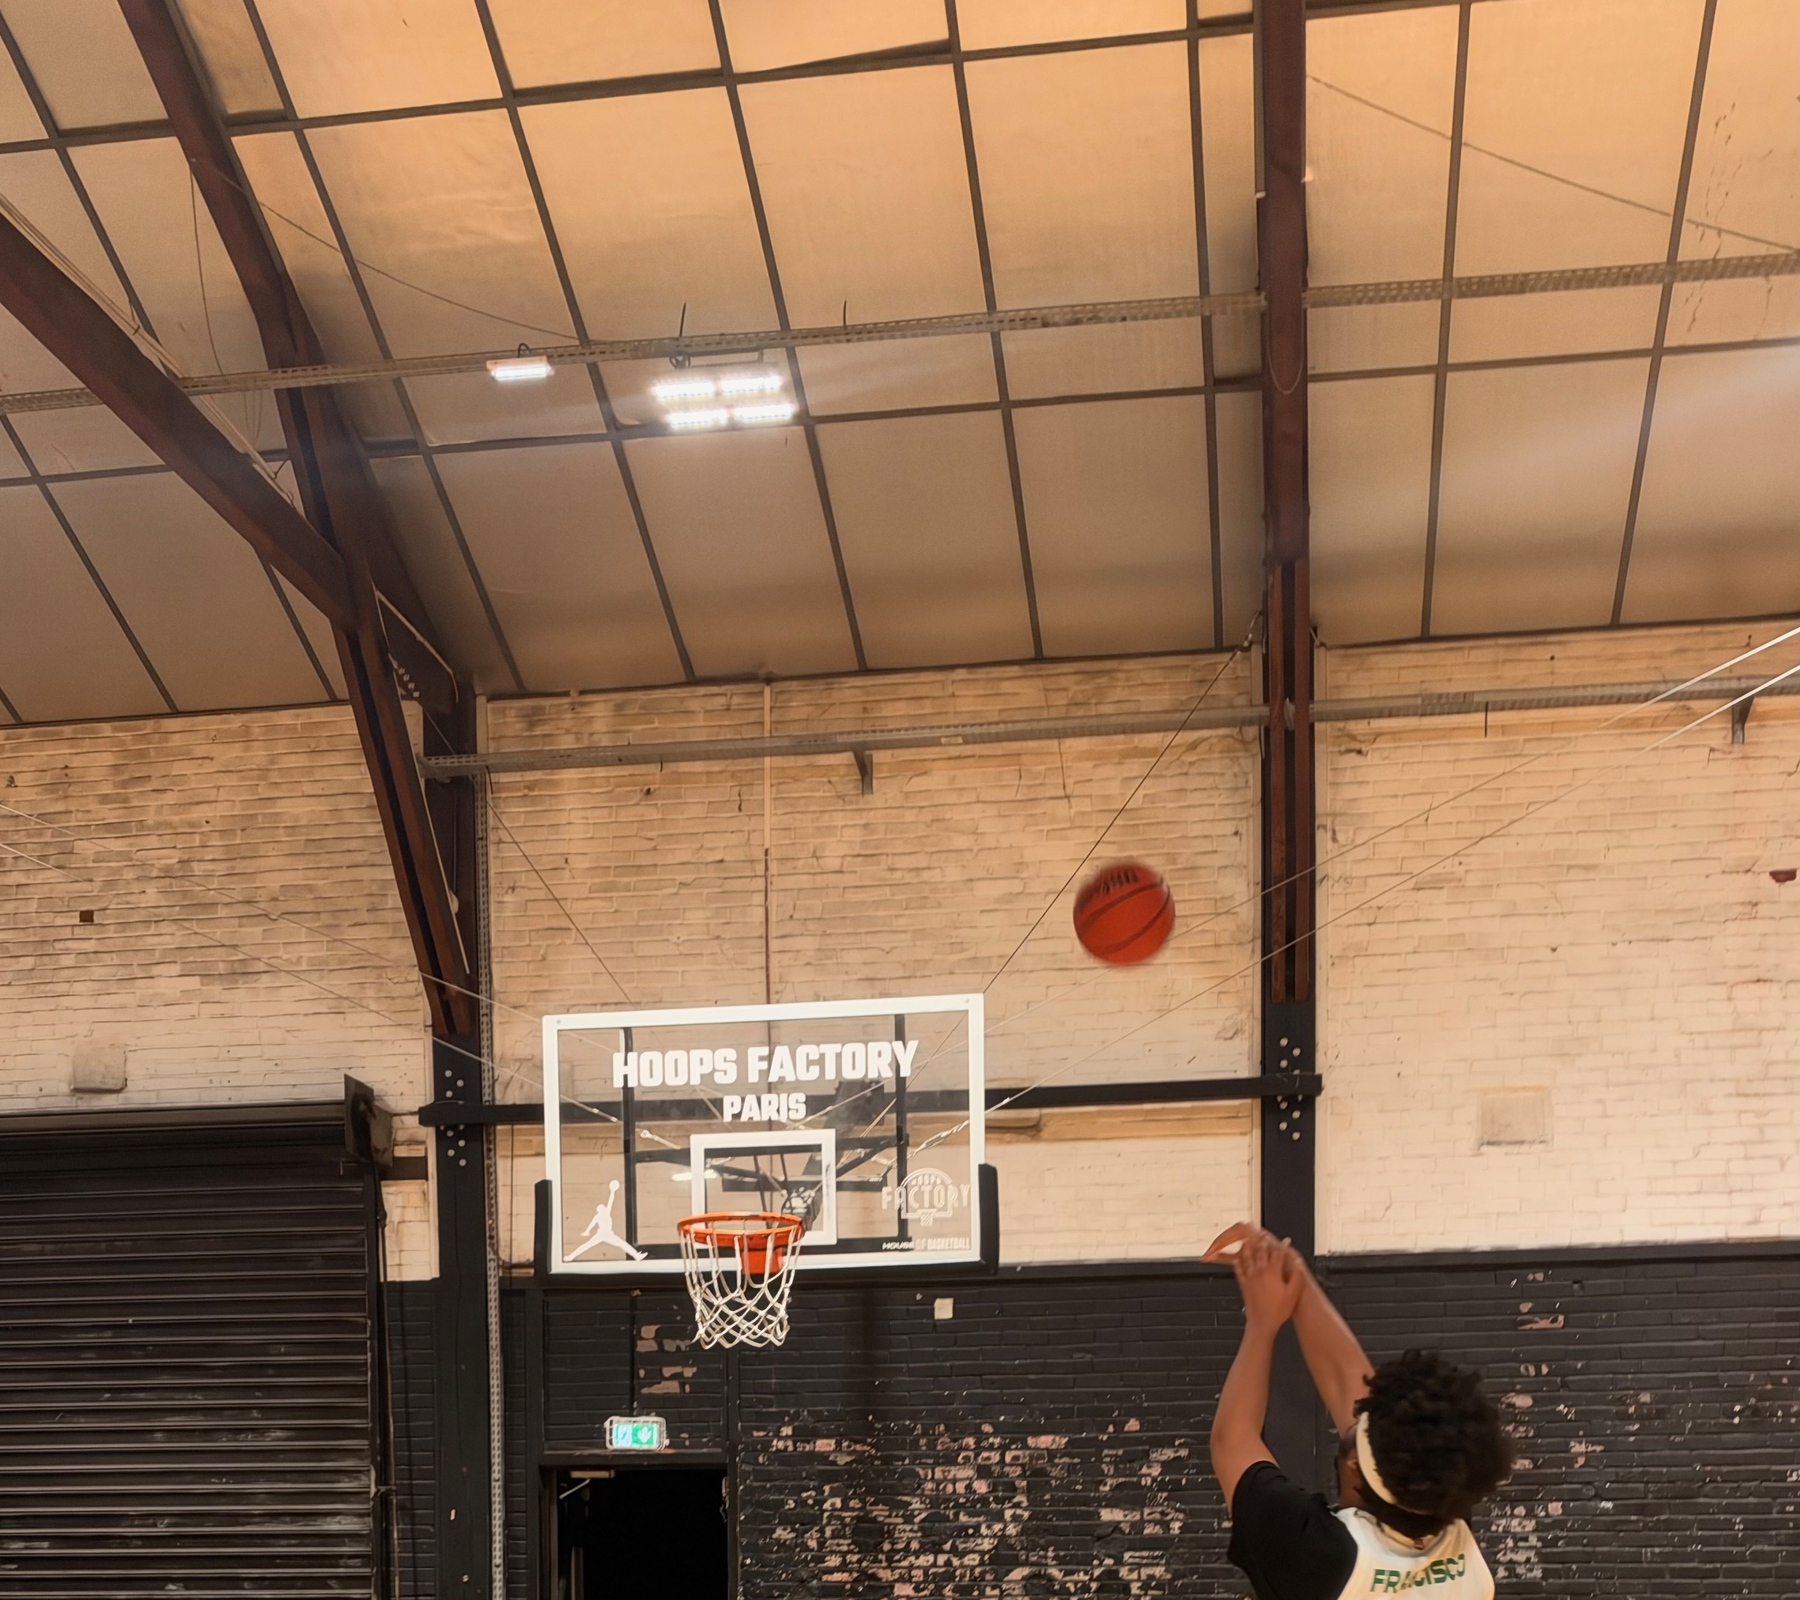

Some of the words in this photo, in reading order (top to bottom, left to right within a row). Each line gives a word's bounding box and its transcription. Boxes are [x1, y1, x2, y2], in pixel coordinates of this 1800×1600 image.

[612, 1048, 738, 1088] HOOPS
[747, 1040, 919, 1083] FACTORY
[723, 1092, 807, 1122] PARIS
[881, 1183, 970, 1210] FACTORY
